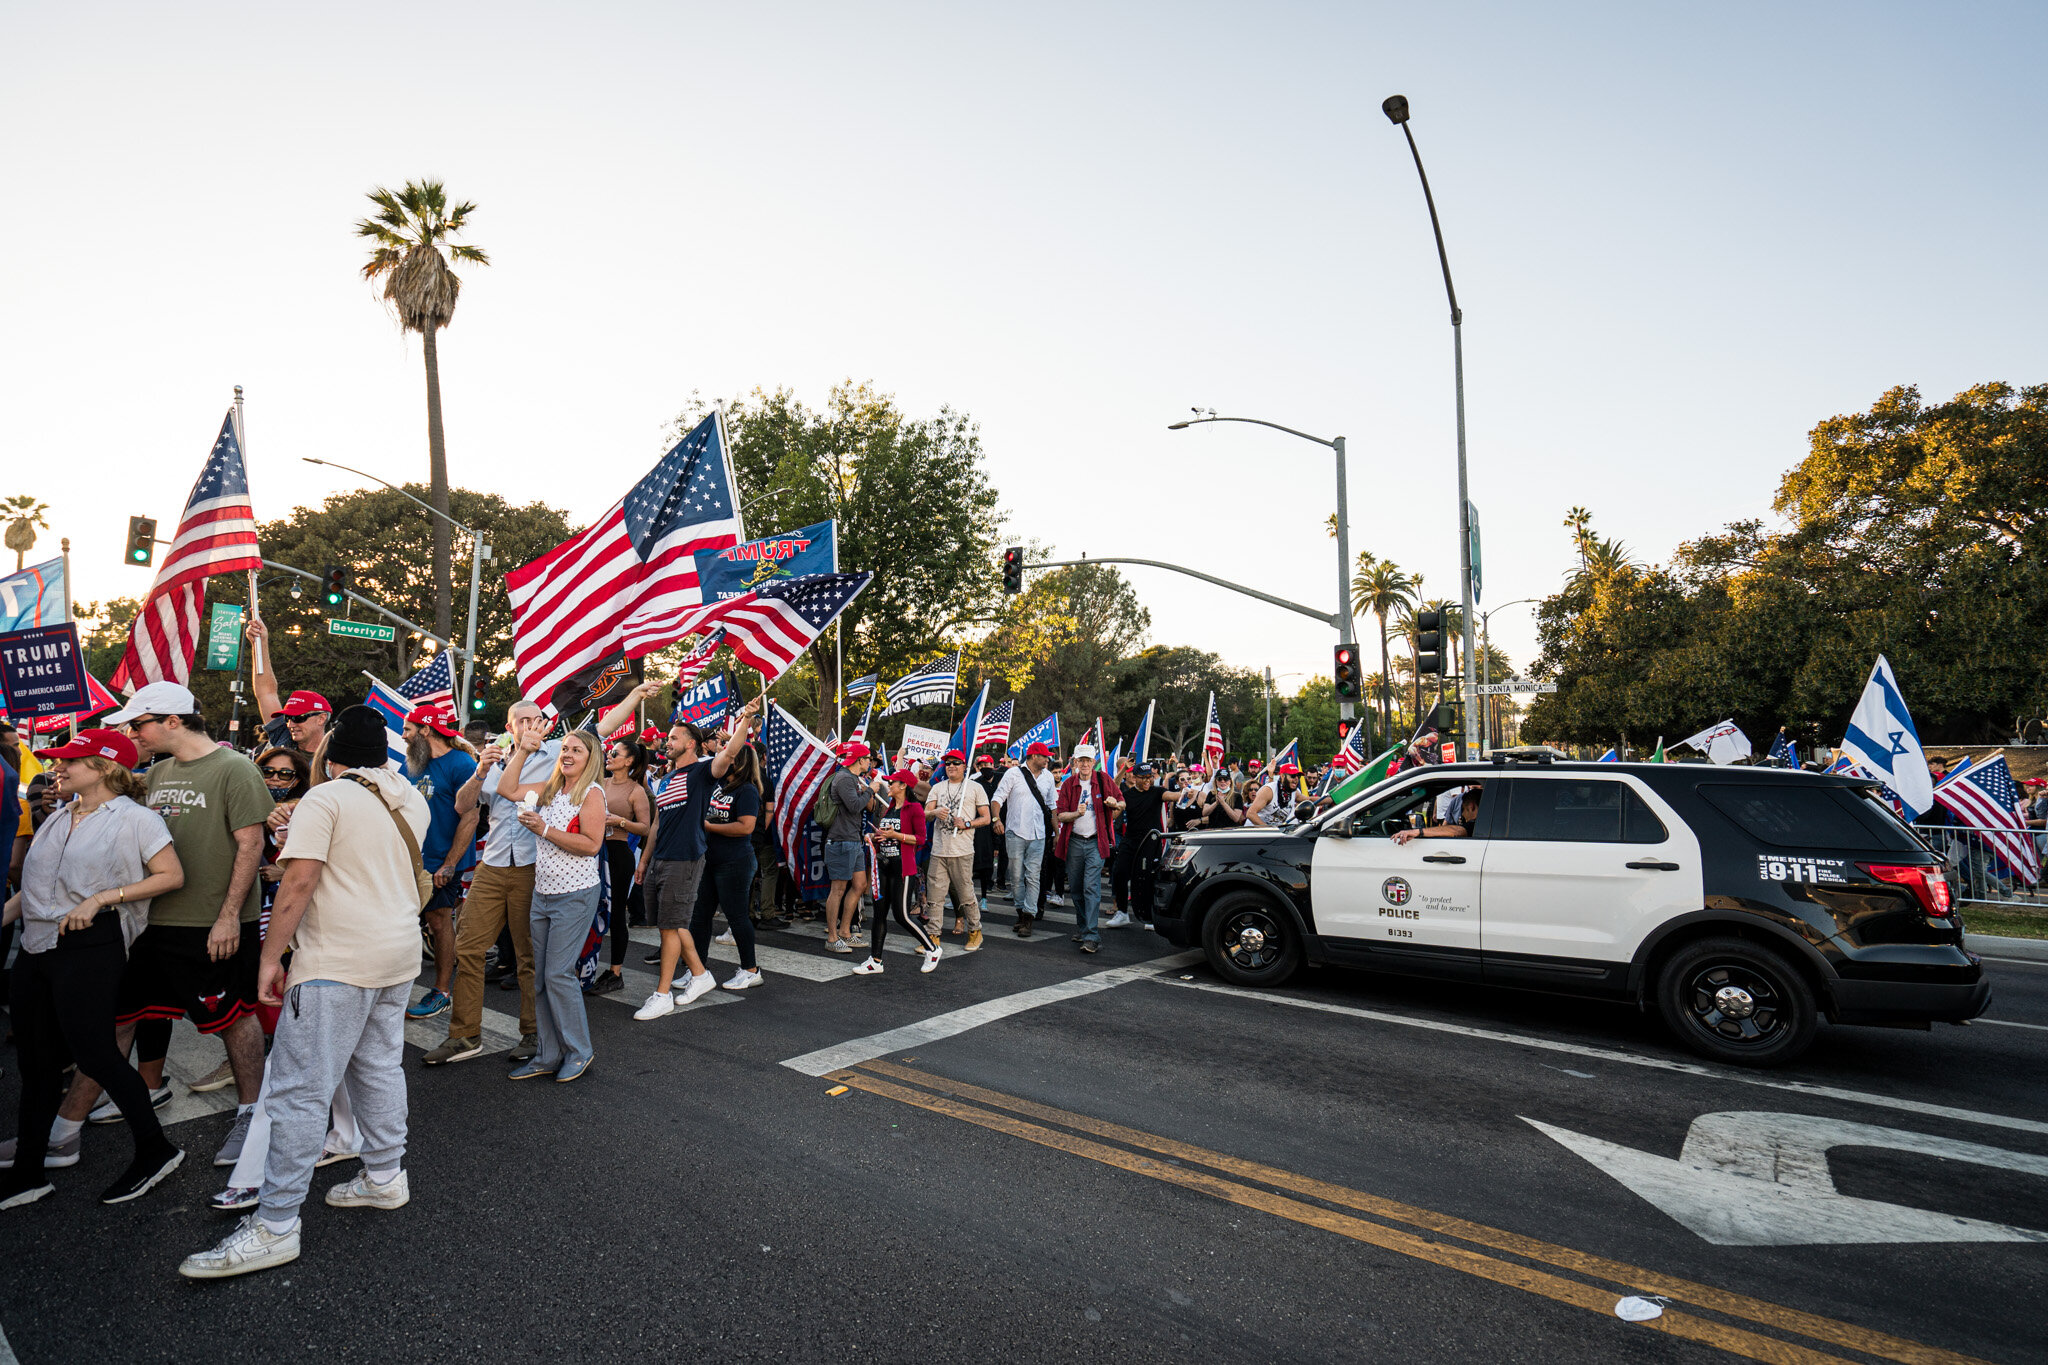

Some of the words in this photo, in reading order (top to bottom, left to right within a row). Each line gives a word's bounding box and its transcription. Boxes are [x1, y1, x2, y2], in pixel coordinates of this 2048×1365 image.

[212, 616, 239, 632] Safe
[333, 622, 376, 638] Beverly
[379, 629, 391, 638] Dr
[3, 641, 71, 665] TRUMP
[18, 662, 62, 679] PENCE
[14, 689, 28, 698] KEEP
[28, 686, 54, 696] AMERICA
[54, 683, 76, 693] GREAT!
[1480, 685, 1484, 693] N
[1488, 685, 1511, 693] SANTA
[1514, 683, 1543, 692] MONICA
[37, 702, 55, 712] 2020
[421, 715, 433, 724] 45
[907, 737, 943, 750] PEACEFUL
[906, 744, 942, 757] PROTEST
[1758, 855, 1845, 867] EMERGENCY
[1760, 861, 1768, 880] CALL
[1429, 896, 1452, 904] protect
[1378, 907, 1420, 920] POLICE
[1441, 903, 1447, 911] to
[1388, 928, 1413, 938] 81393
